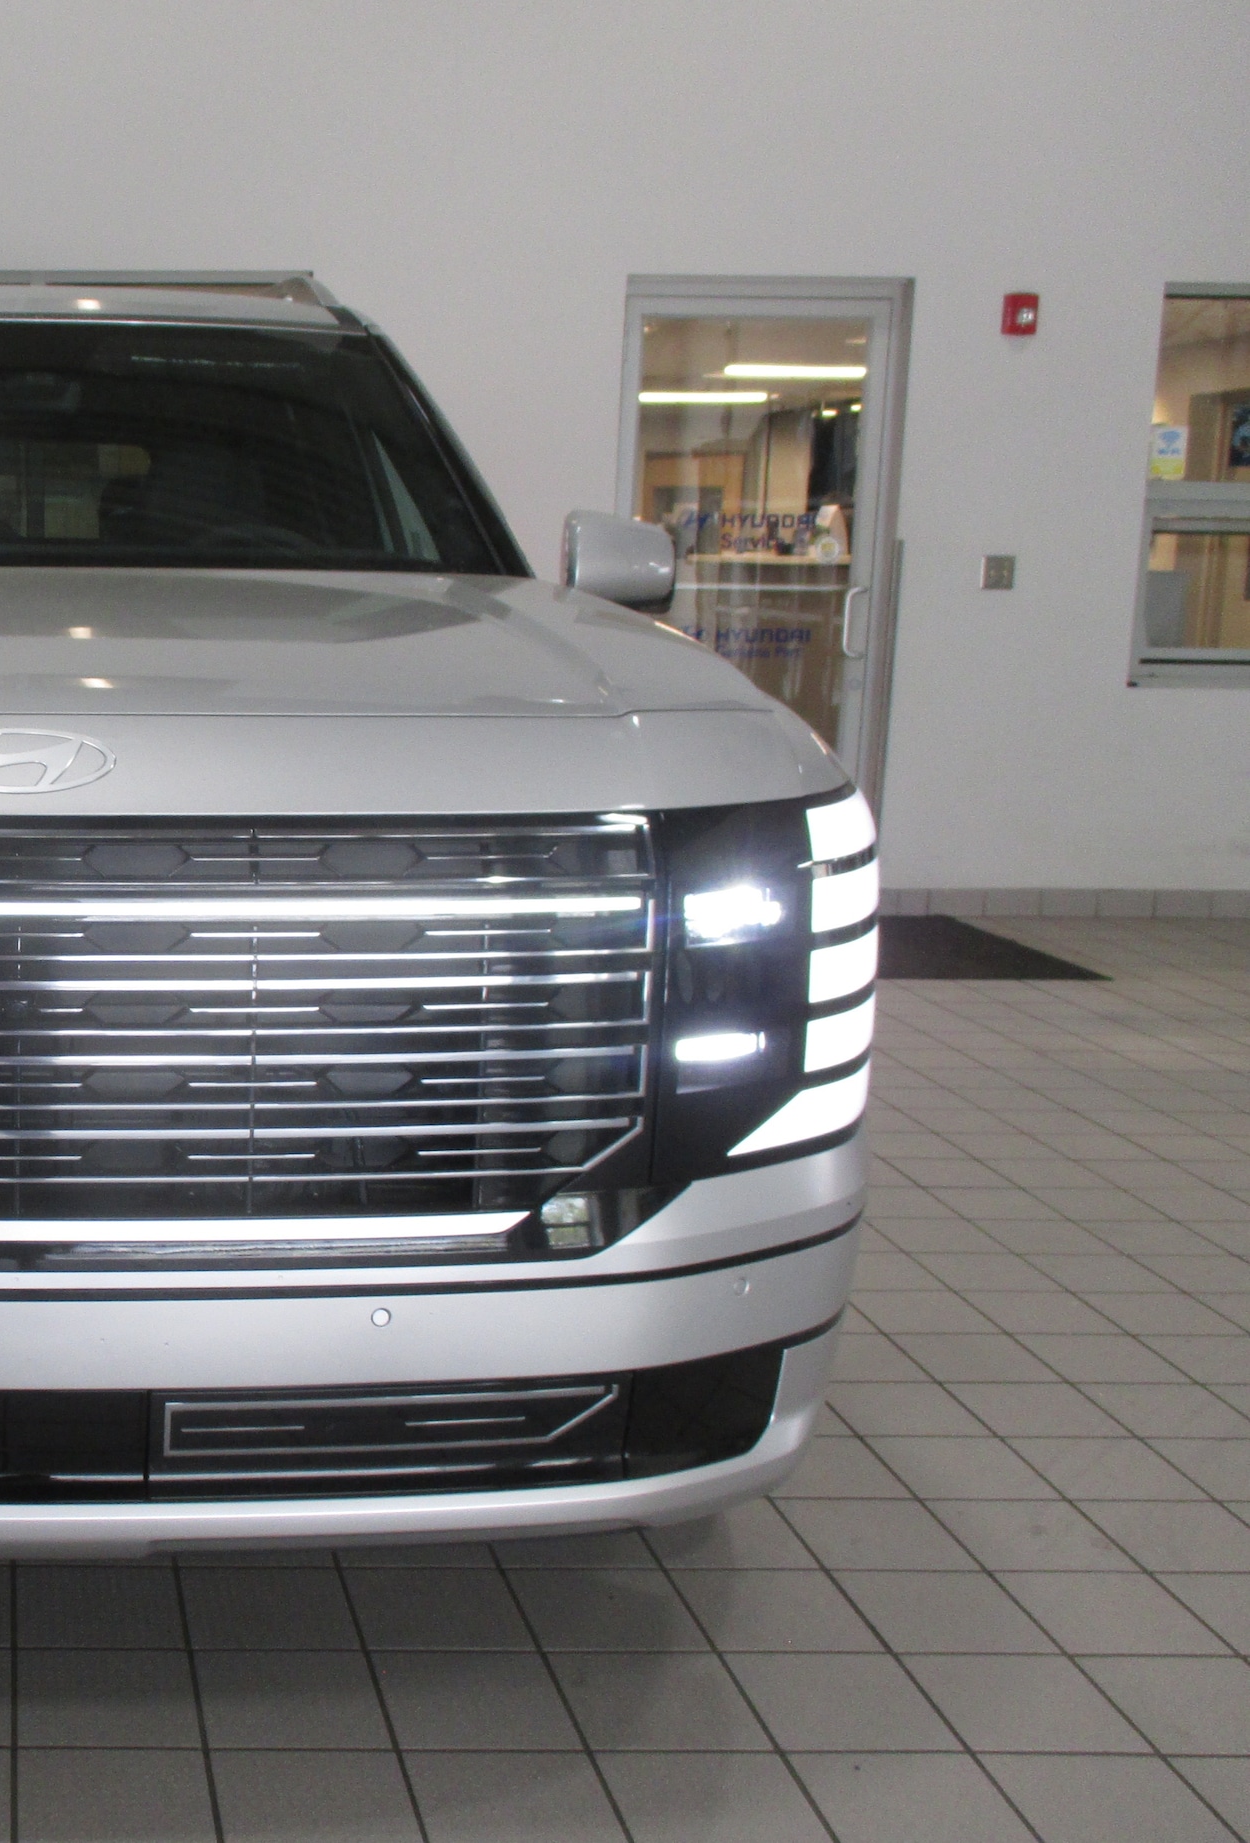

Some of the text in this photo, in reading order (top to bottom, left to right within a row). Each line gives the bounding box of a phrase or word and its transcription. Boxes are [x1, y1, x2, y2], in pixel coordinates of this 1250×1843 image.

[720, 513, 816, 528] HYUNDAI
[720, 533, 783, 549] Servic
[717, 627, 811, 642] HYUNDAI
